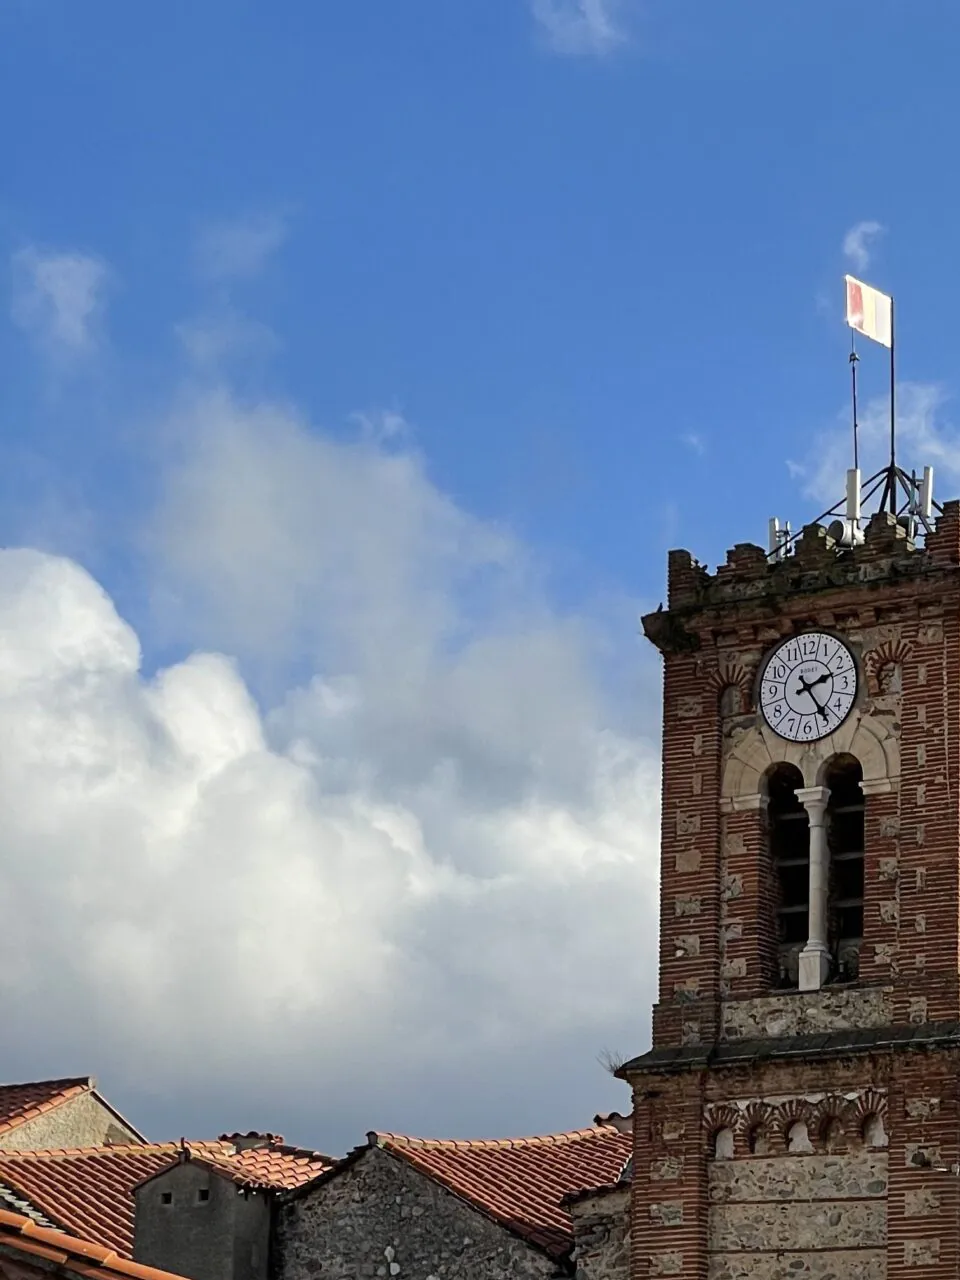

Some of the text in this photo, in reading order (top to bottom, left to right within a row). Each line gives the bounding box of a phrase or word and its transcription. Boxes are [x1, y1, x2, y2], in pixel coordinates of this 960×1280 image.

[787, 648, 798, 661] 11
[803, 641, 815, 655] 12
[824, 644, 828, 656] 1
[837, 656, 843, 669] 2
[773, 665, 785, 679] 10
[841, 676, 848, 689] 3
[769, 686, 777, 699] 9
[834, 697, 841, 711] 4
[774, 705, 781, 718] 8
[788, 719, 795, 732] 7
[822, 713, 830, 727] 5
[804, 721, 811, 734] 6
